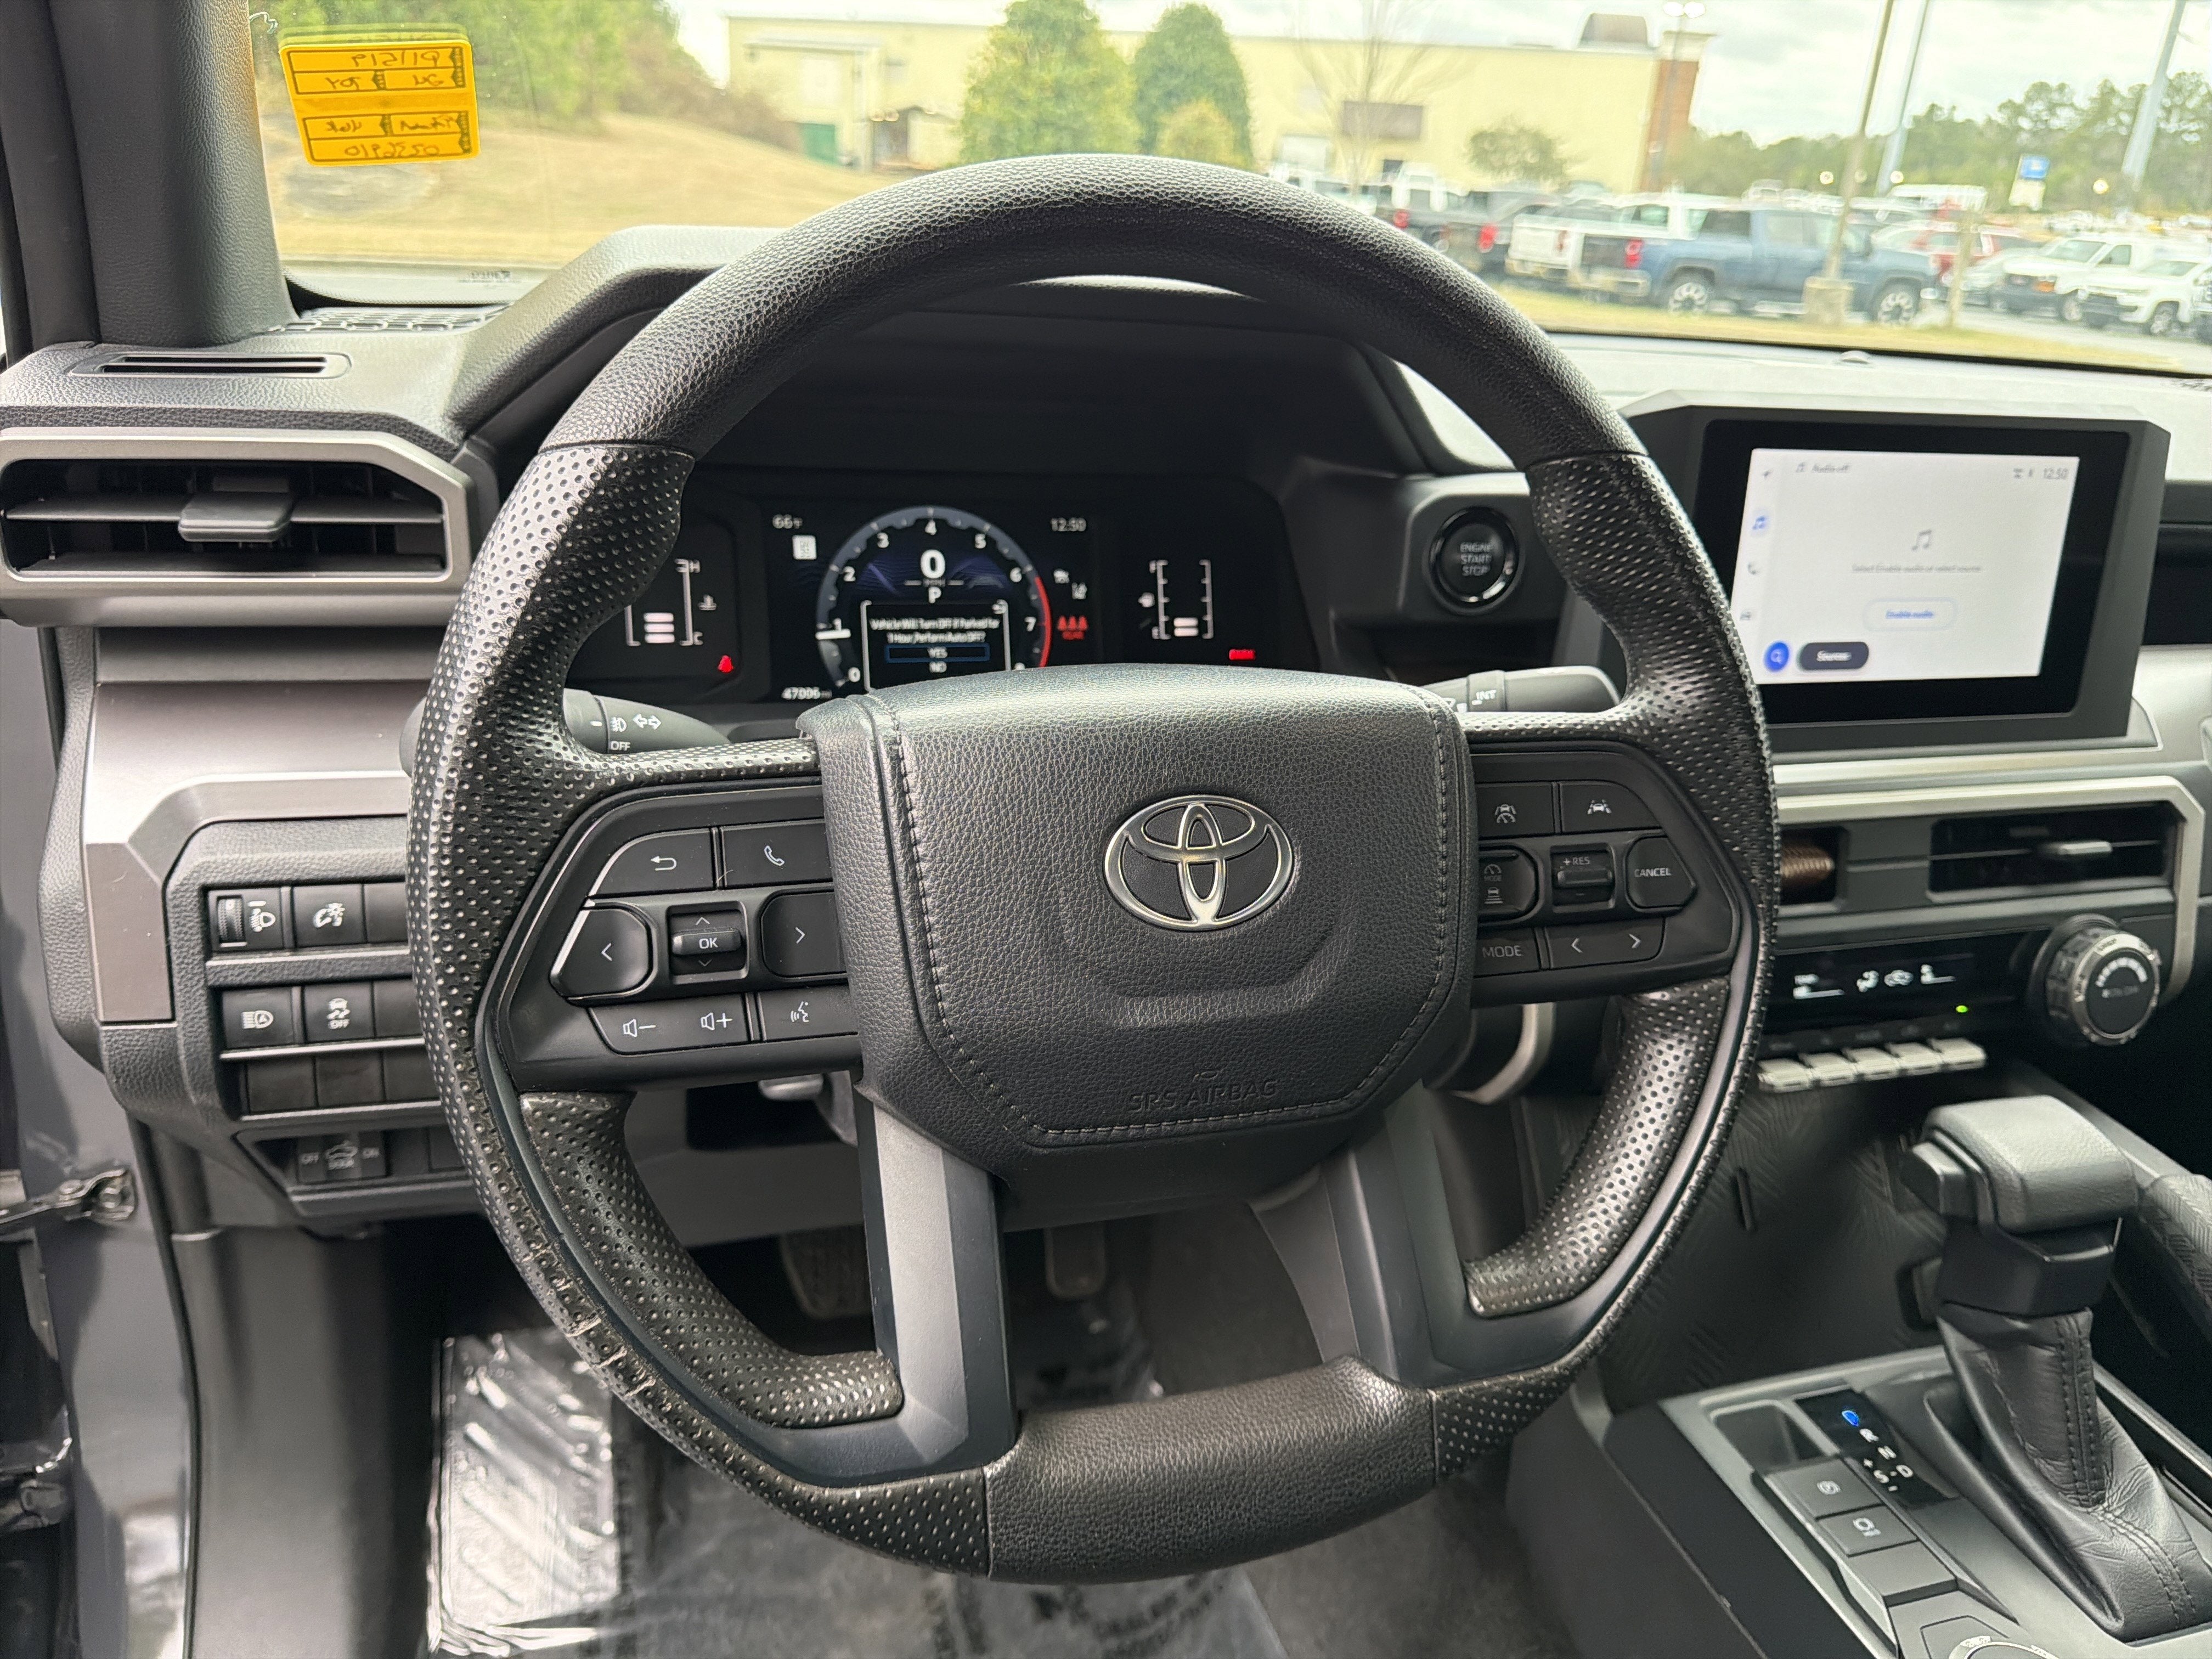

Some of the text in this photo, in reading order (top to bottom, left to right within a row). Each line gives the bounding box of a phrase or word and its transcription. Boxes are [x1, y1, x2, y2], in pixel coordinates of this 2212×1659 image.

[925, 520, 937, 535] 4
[878, 533, 889, 548] 3
[975, 534, 986, 549] 5
[1460, 542, 1492, 552] ENGINE
[920, 550, 946, 579] 0
[1460, 553, 1492, 565] START
[844, 566, 856, 582] 2
[1010, 567, 1022, 583] 6
[1462, 565, 1491, 576] STOP
[928, 586, 941, 604] P
[1024, 616, 1037, 631] 7
[848, 667, 861, 682] 0
[610, 741, 630, 752] OFF
[1634, 867, 1672, 878] CANCEL
[699, 937, 719, 949] OK
[1482, 944, 1524, 959] MODE
[328, 1019, 351, 1029] OFF
[1184, 1079, 1279, 1106] AIRBAG
